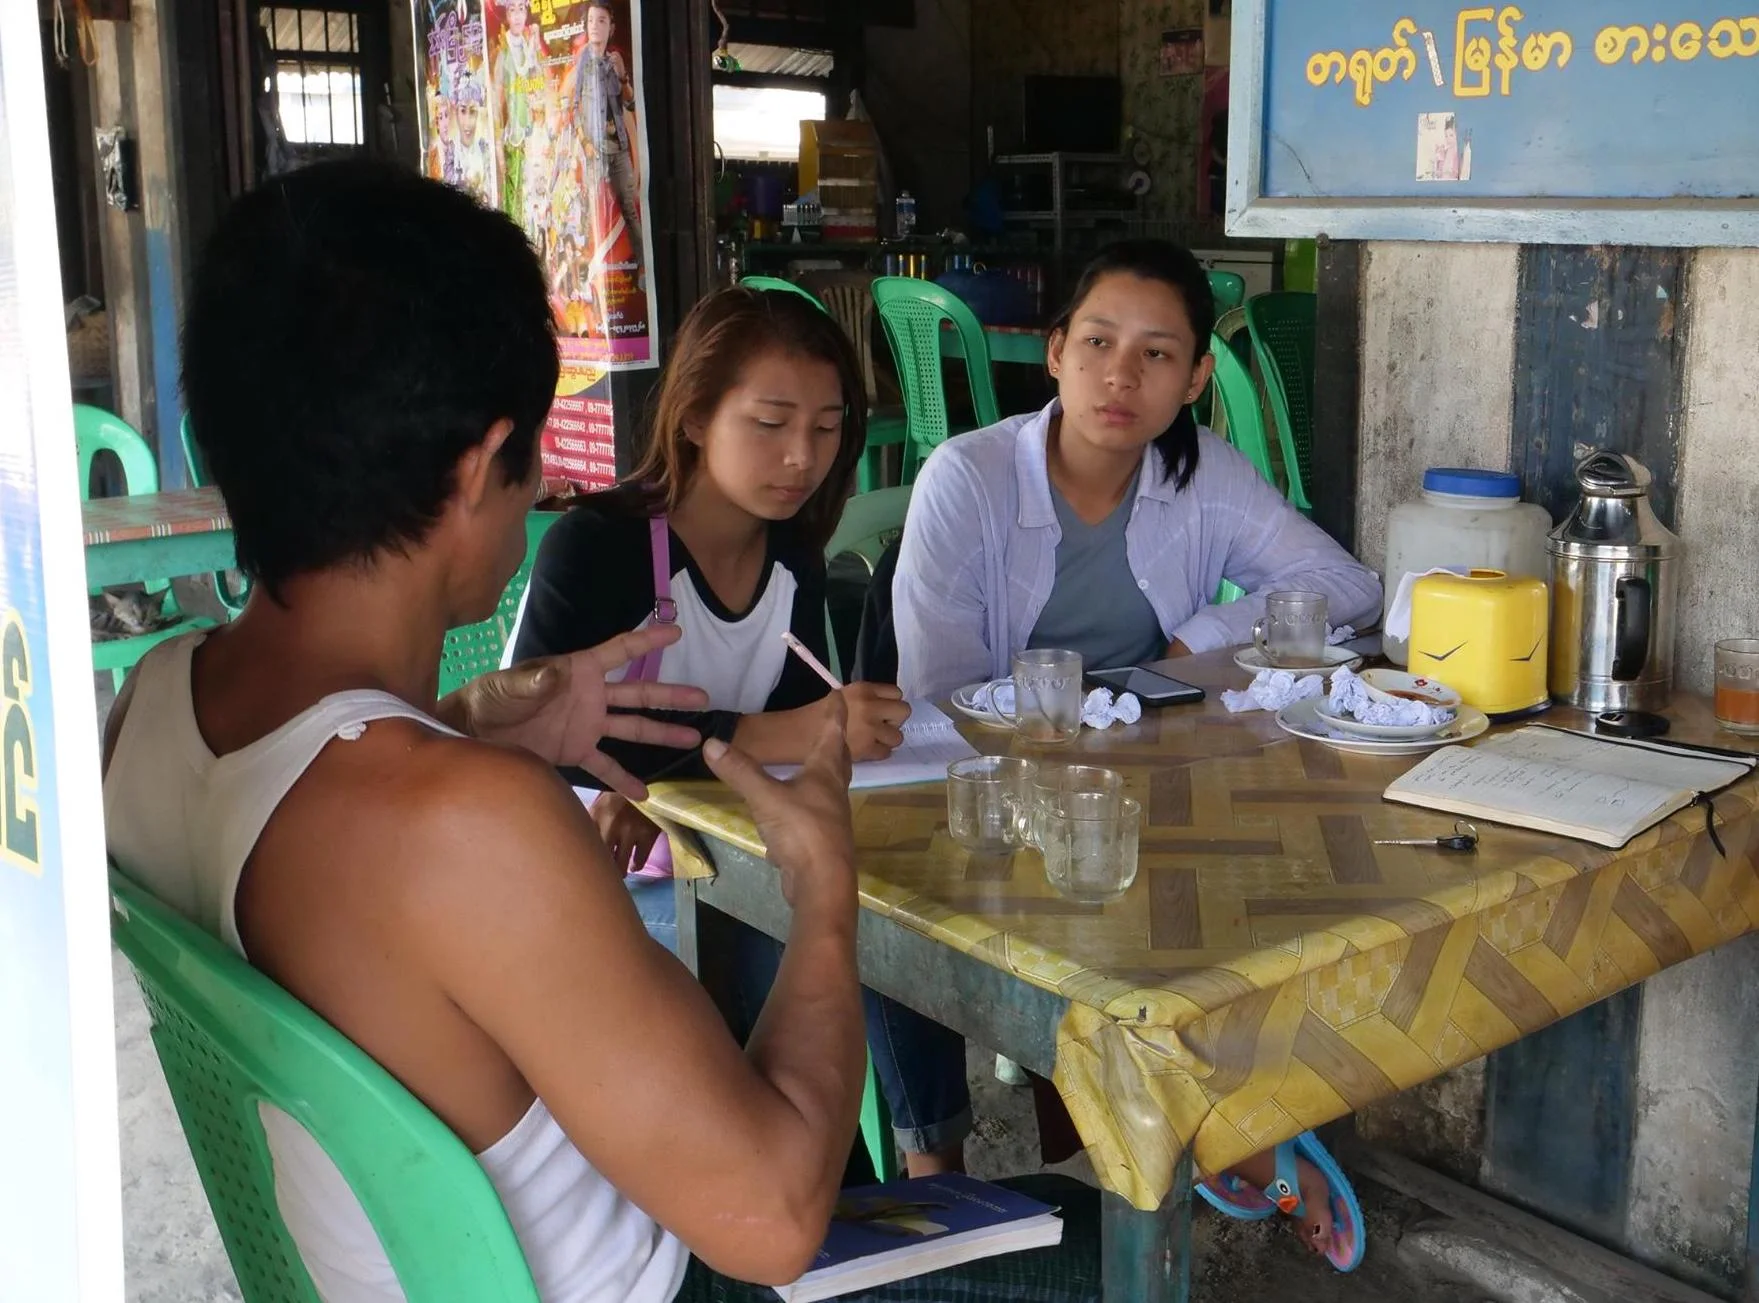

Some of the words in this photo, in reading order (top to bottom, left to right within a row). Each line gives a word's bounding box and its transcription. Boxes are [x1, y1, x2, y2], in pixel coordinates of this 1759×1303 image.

[1306, 17, 1417, 107] တရုတ်
[1453, 5, 1573, 97] မြန်မာ
